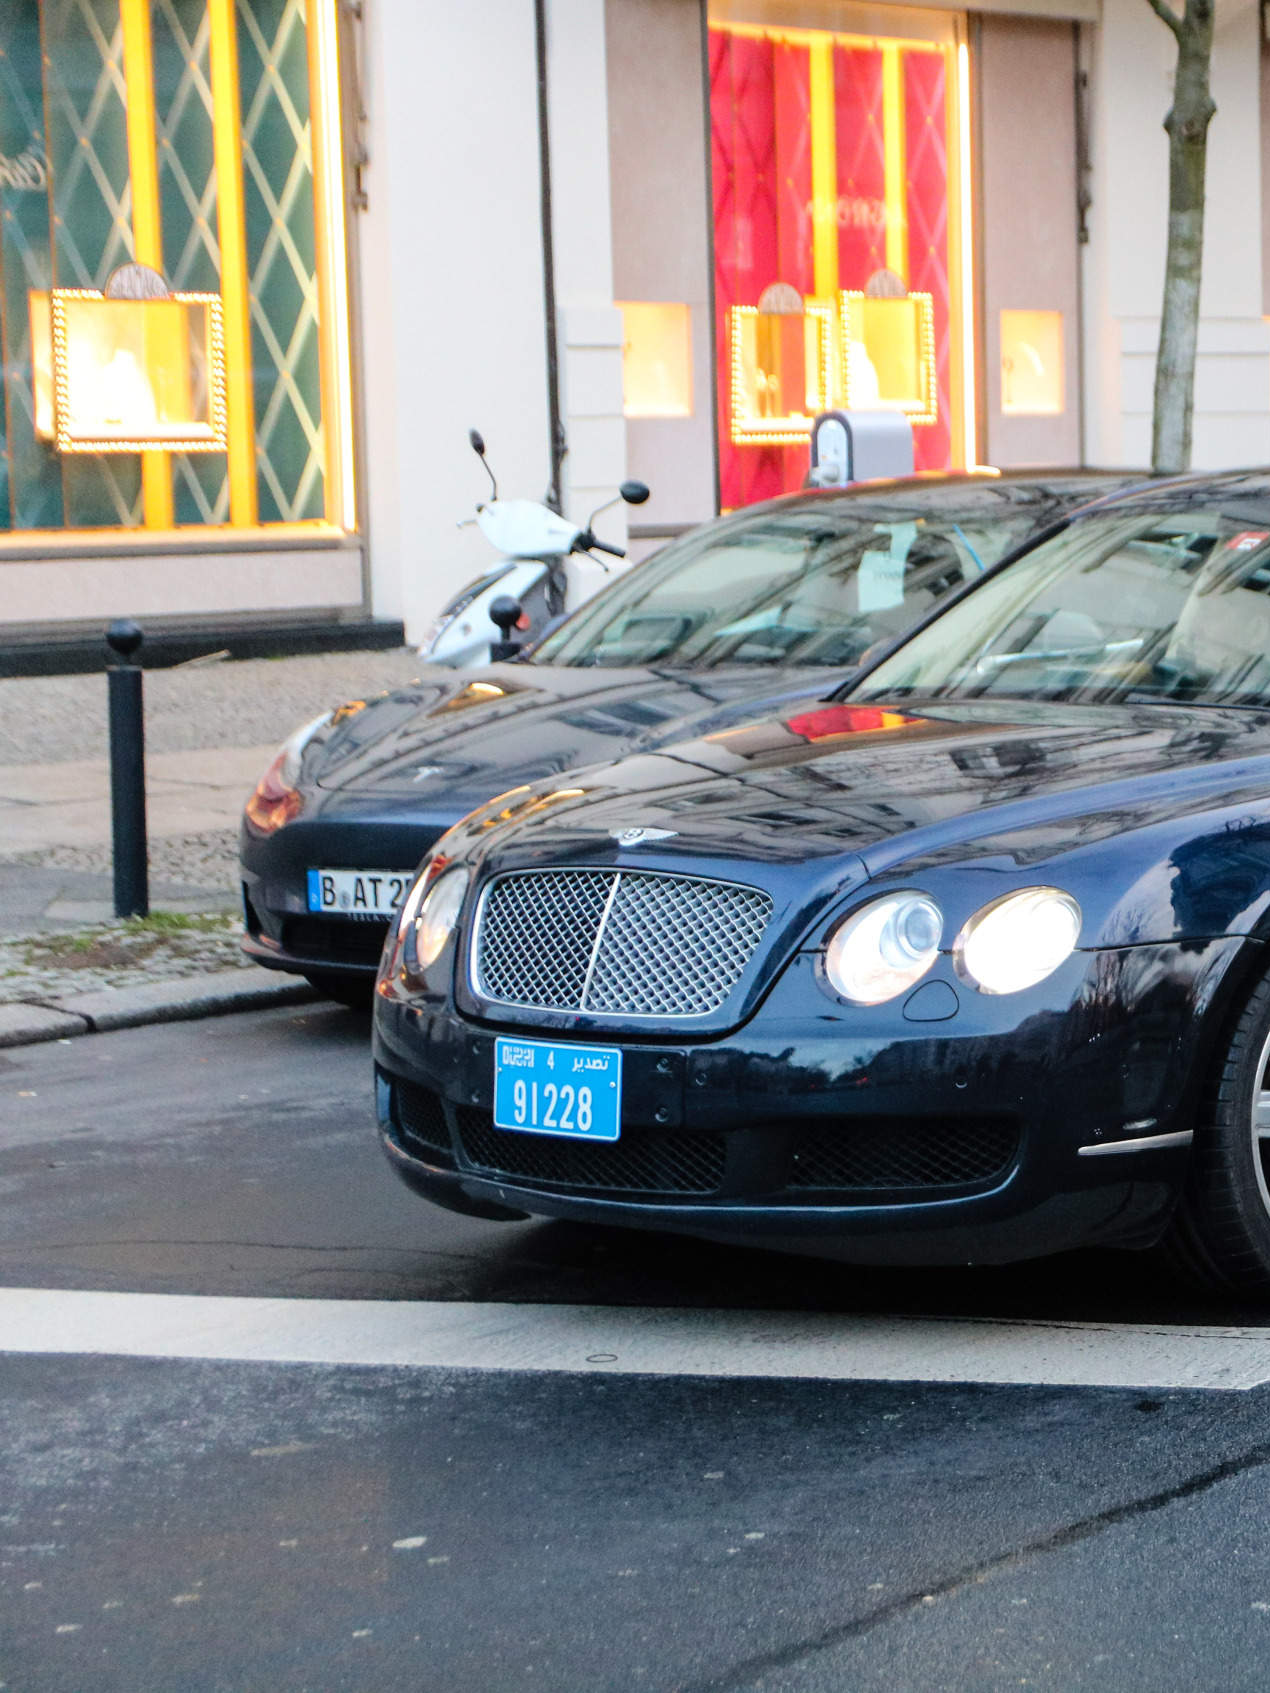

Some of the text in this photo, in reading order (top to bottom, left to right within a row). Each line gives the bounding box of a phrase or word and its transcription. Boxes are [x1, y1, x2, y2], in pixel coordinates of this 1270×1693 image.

[322, 876, 335, 906] B
[354, 877, 382, 908] AT
[546, 1050, 555, 1070] 4
[513, 1079, 593, 1131] 91228
